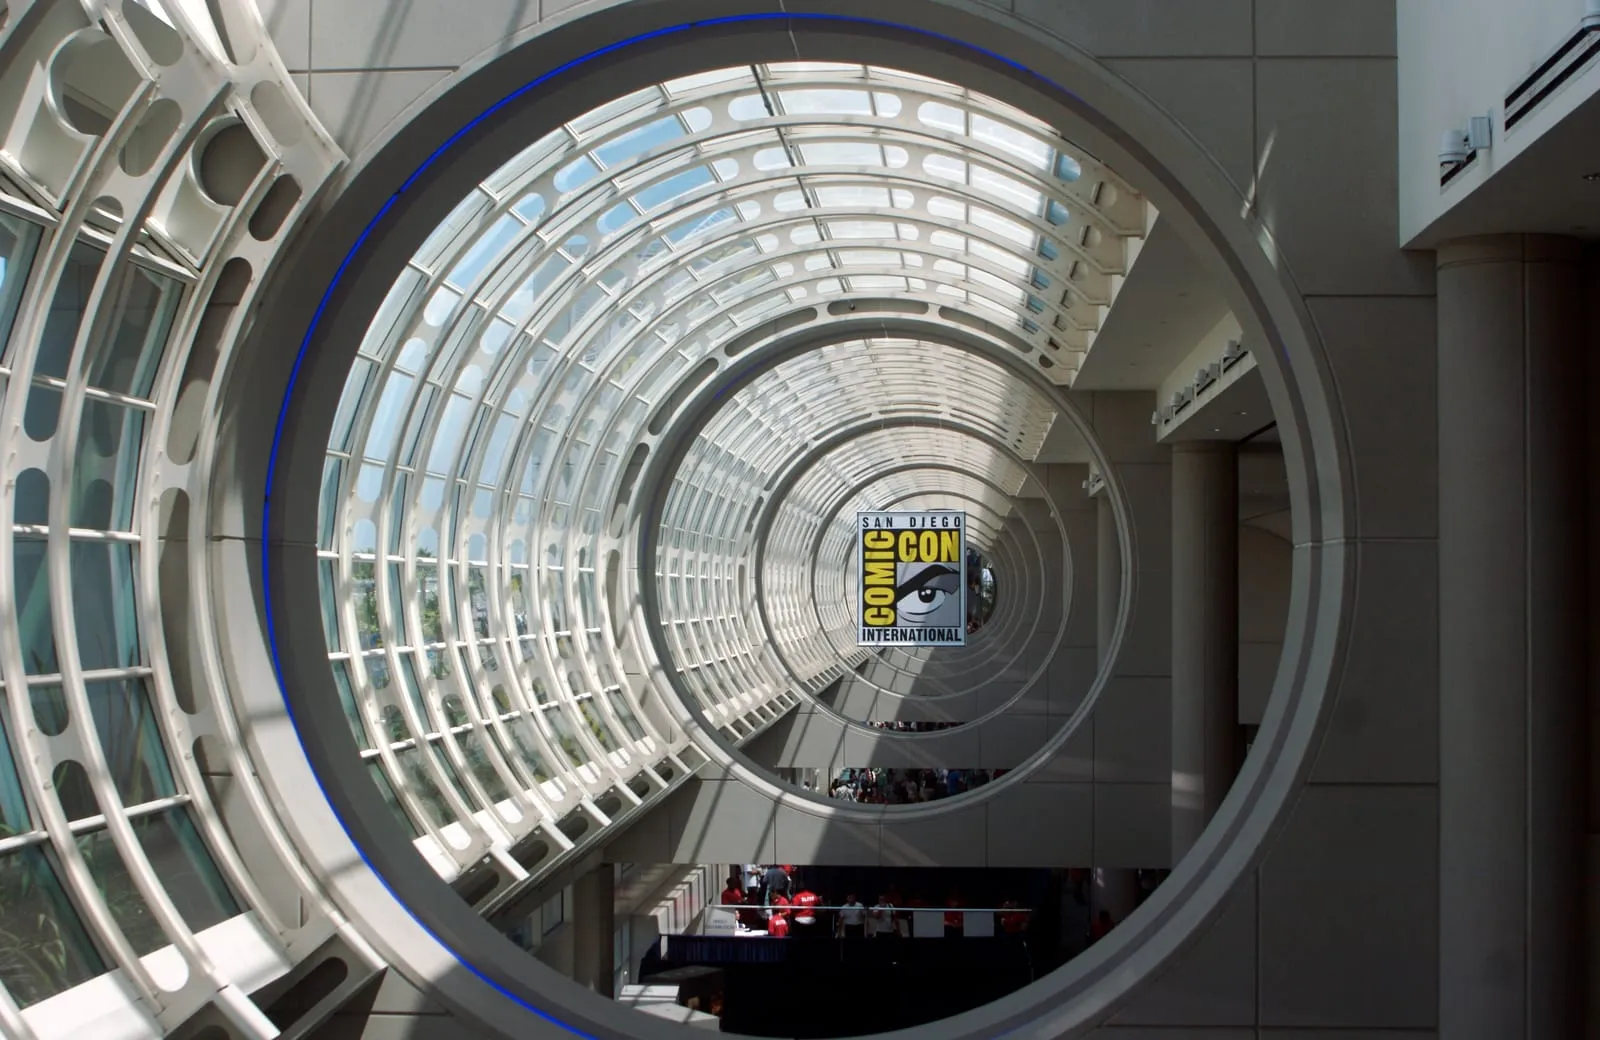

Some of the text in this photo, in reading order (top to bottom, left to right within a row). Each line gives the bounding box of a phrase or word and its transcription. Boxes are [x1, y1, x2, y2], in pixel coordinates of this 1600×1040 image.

[862, 516, 961, 528] SAN DIEGO
[898, 530, 959, 563] CON
[864, 530, 895, 626] COMIC
[862, 628, 962, 641] INTERNATIONAL
